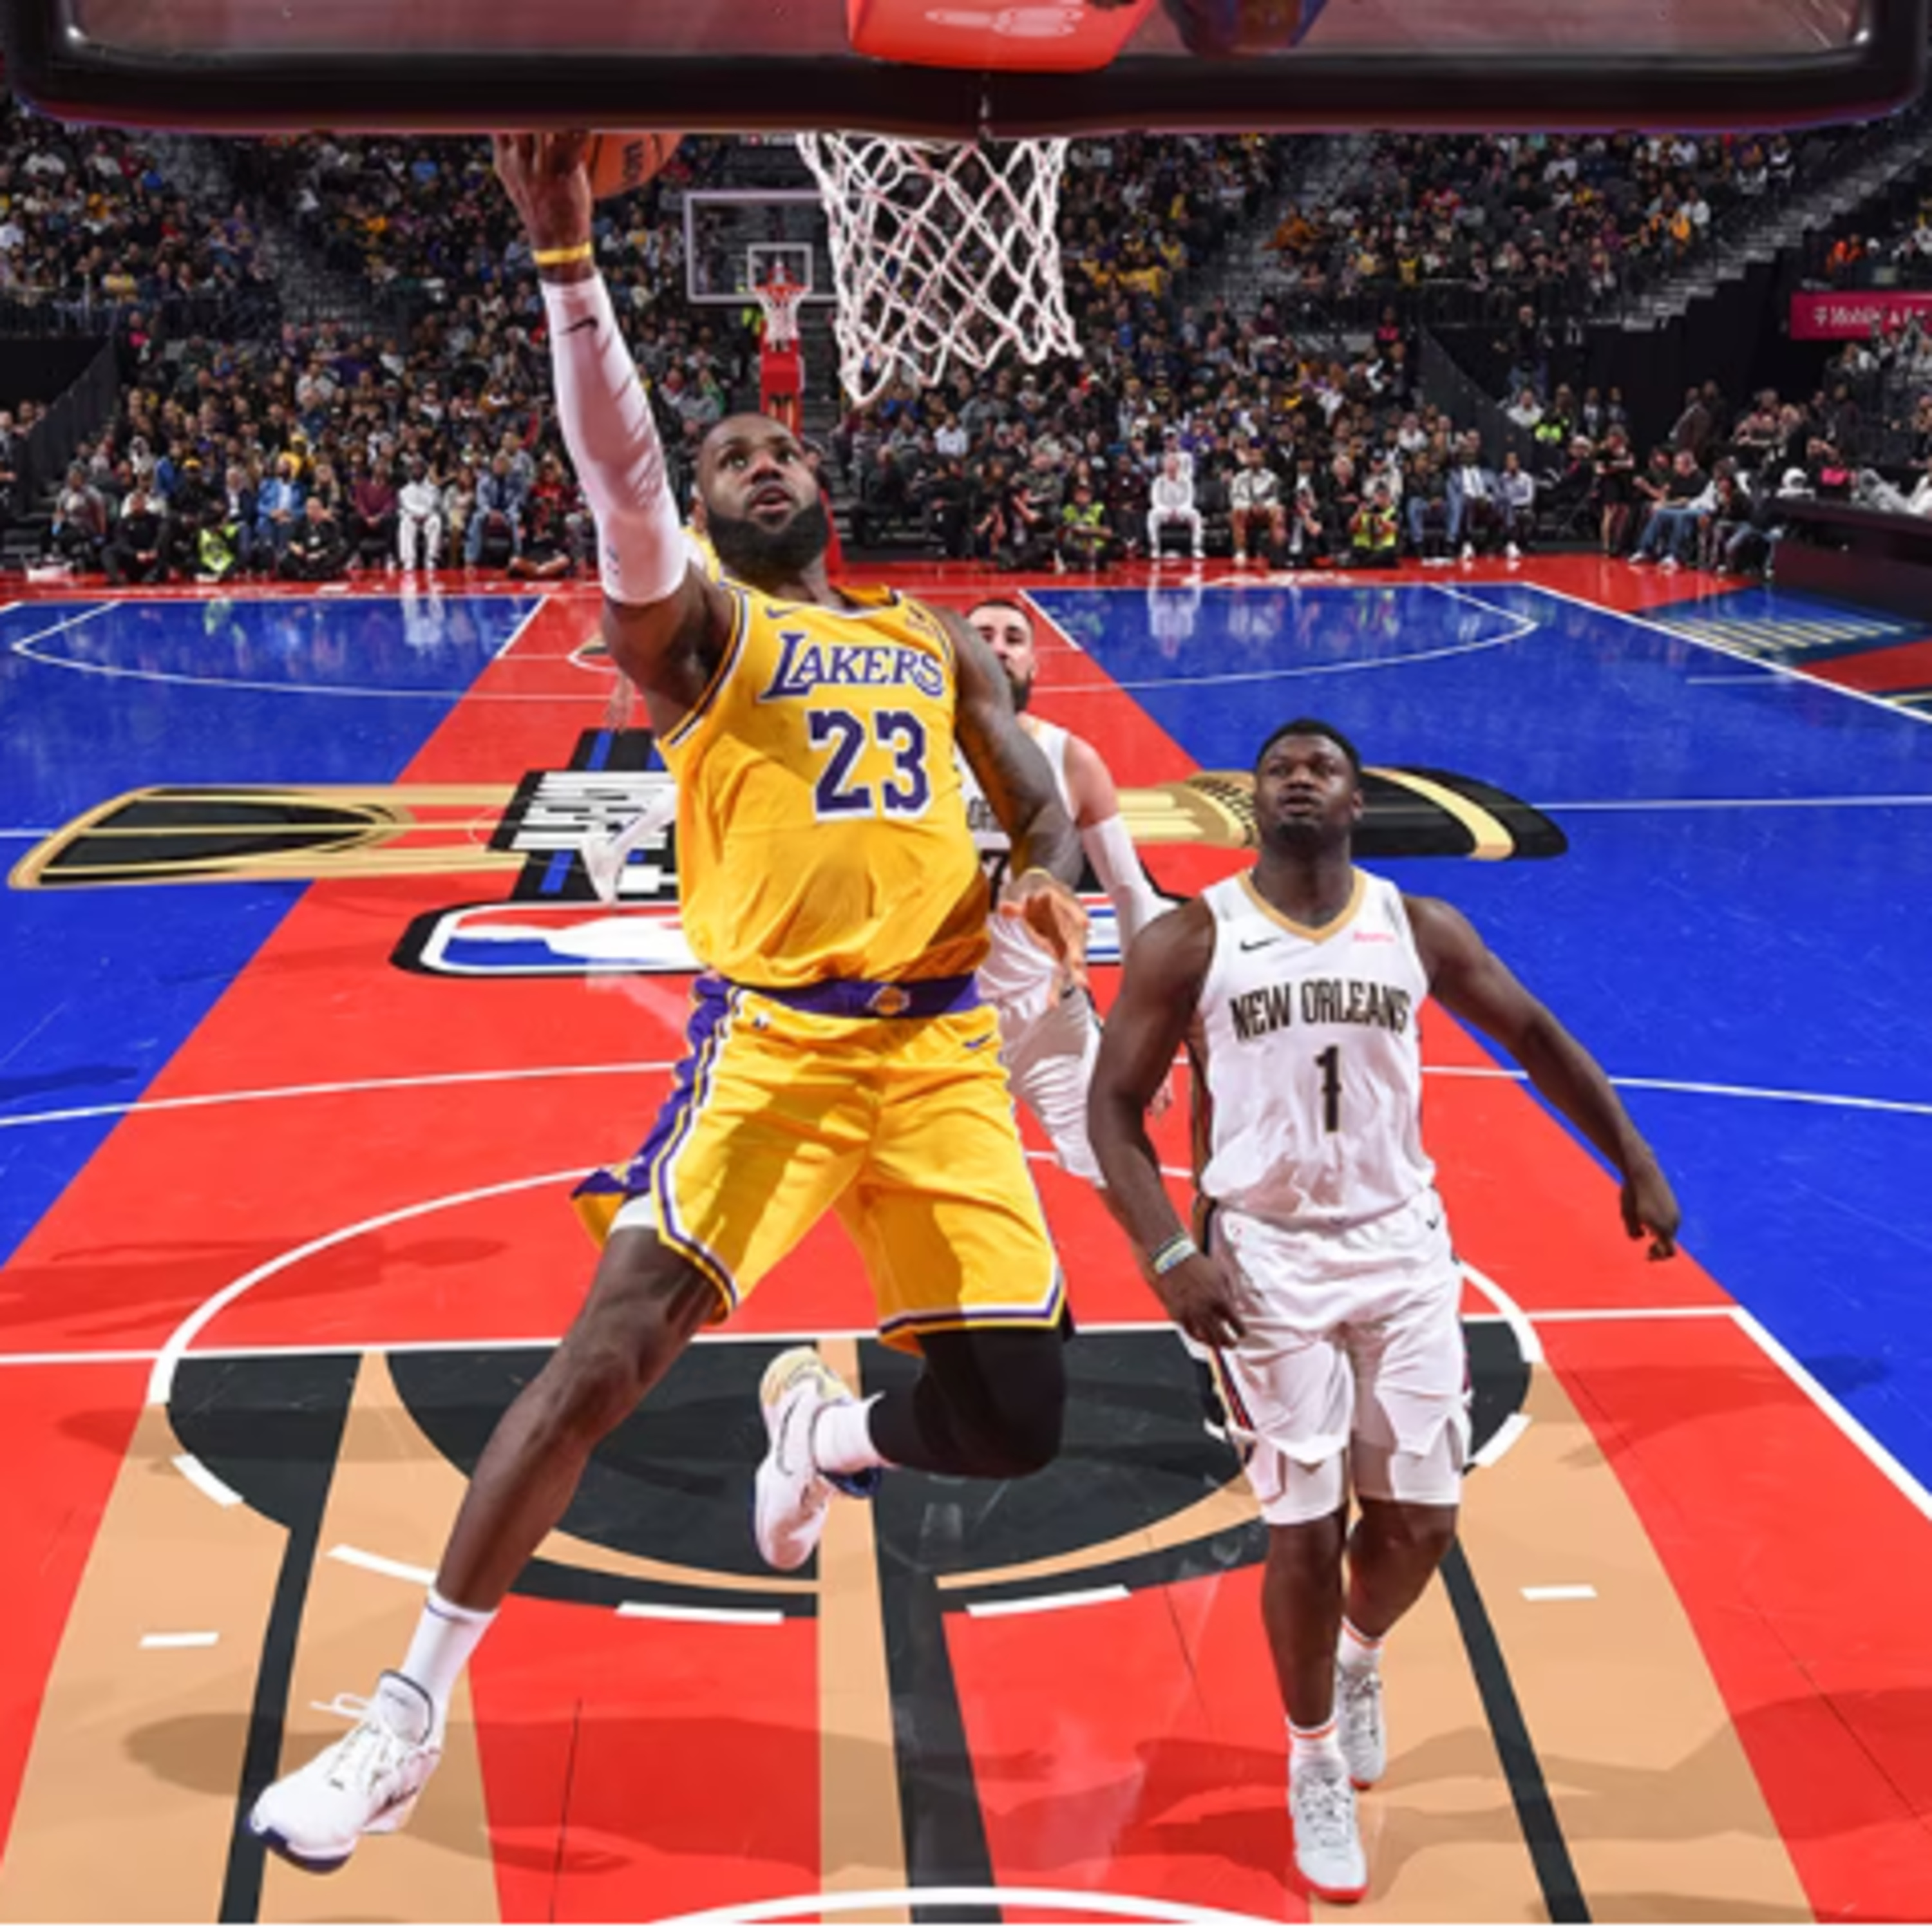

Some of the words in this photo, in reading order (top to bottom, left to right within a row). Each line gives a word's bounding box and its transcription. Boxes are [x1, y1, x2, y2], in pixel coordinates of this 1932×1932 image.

[759, 632, 943, 698] LAKERS
[807, 709, 929, 820] 23
[1229, 982, 1291, 1042] NEW
[1300, 978, 1412, 1034] ORLEANS
[1314, 1044, 1342, 1134] 1
